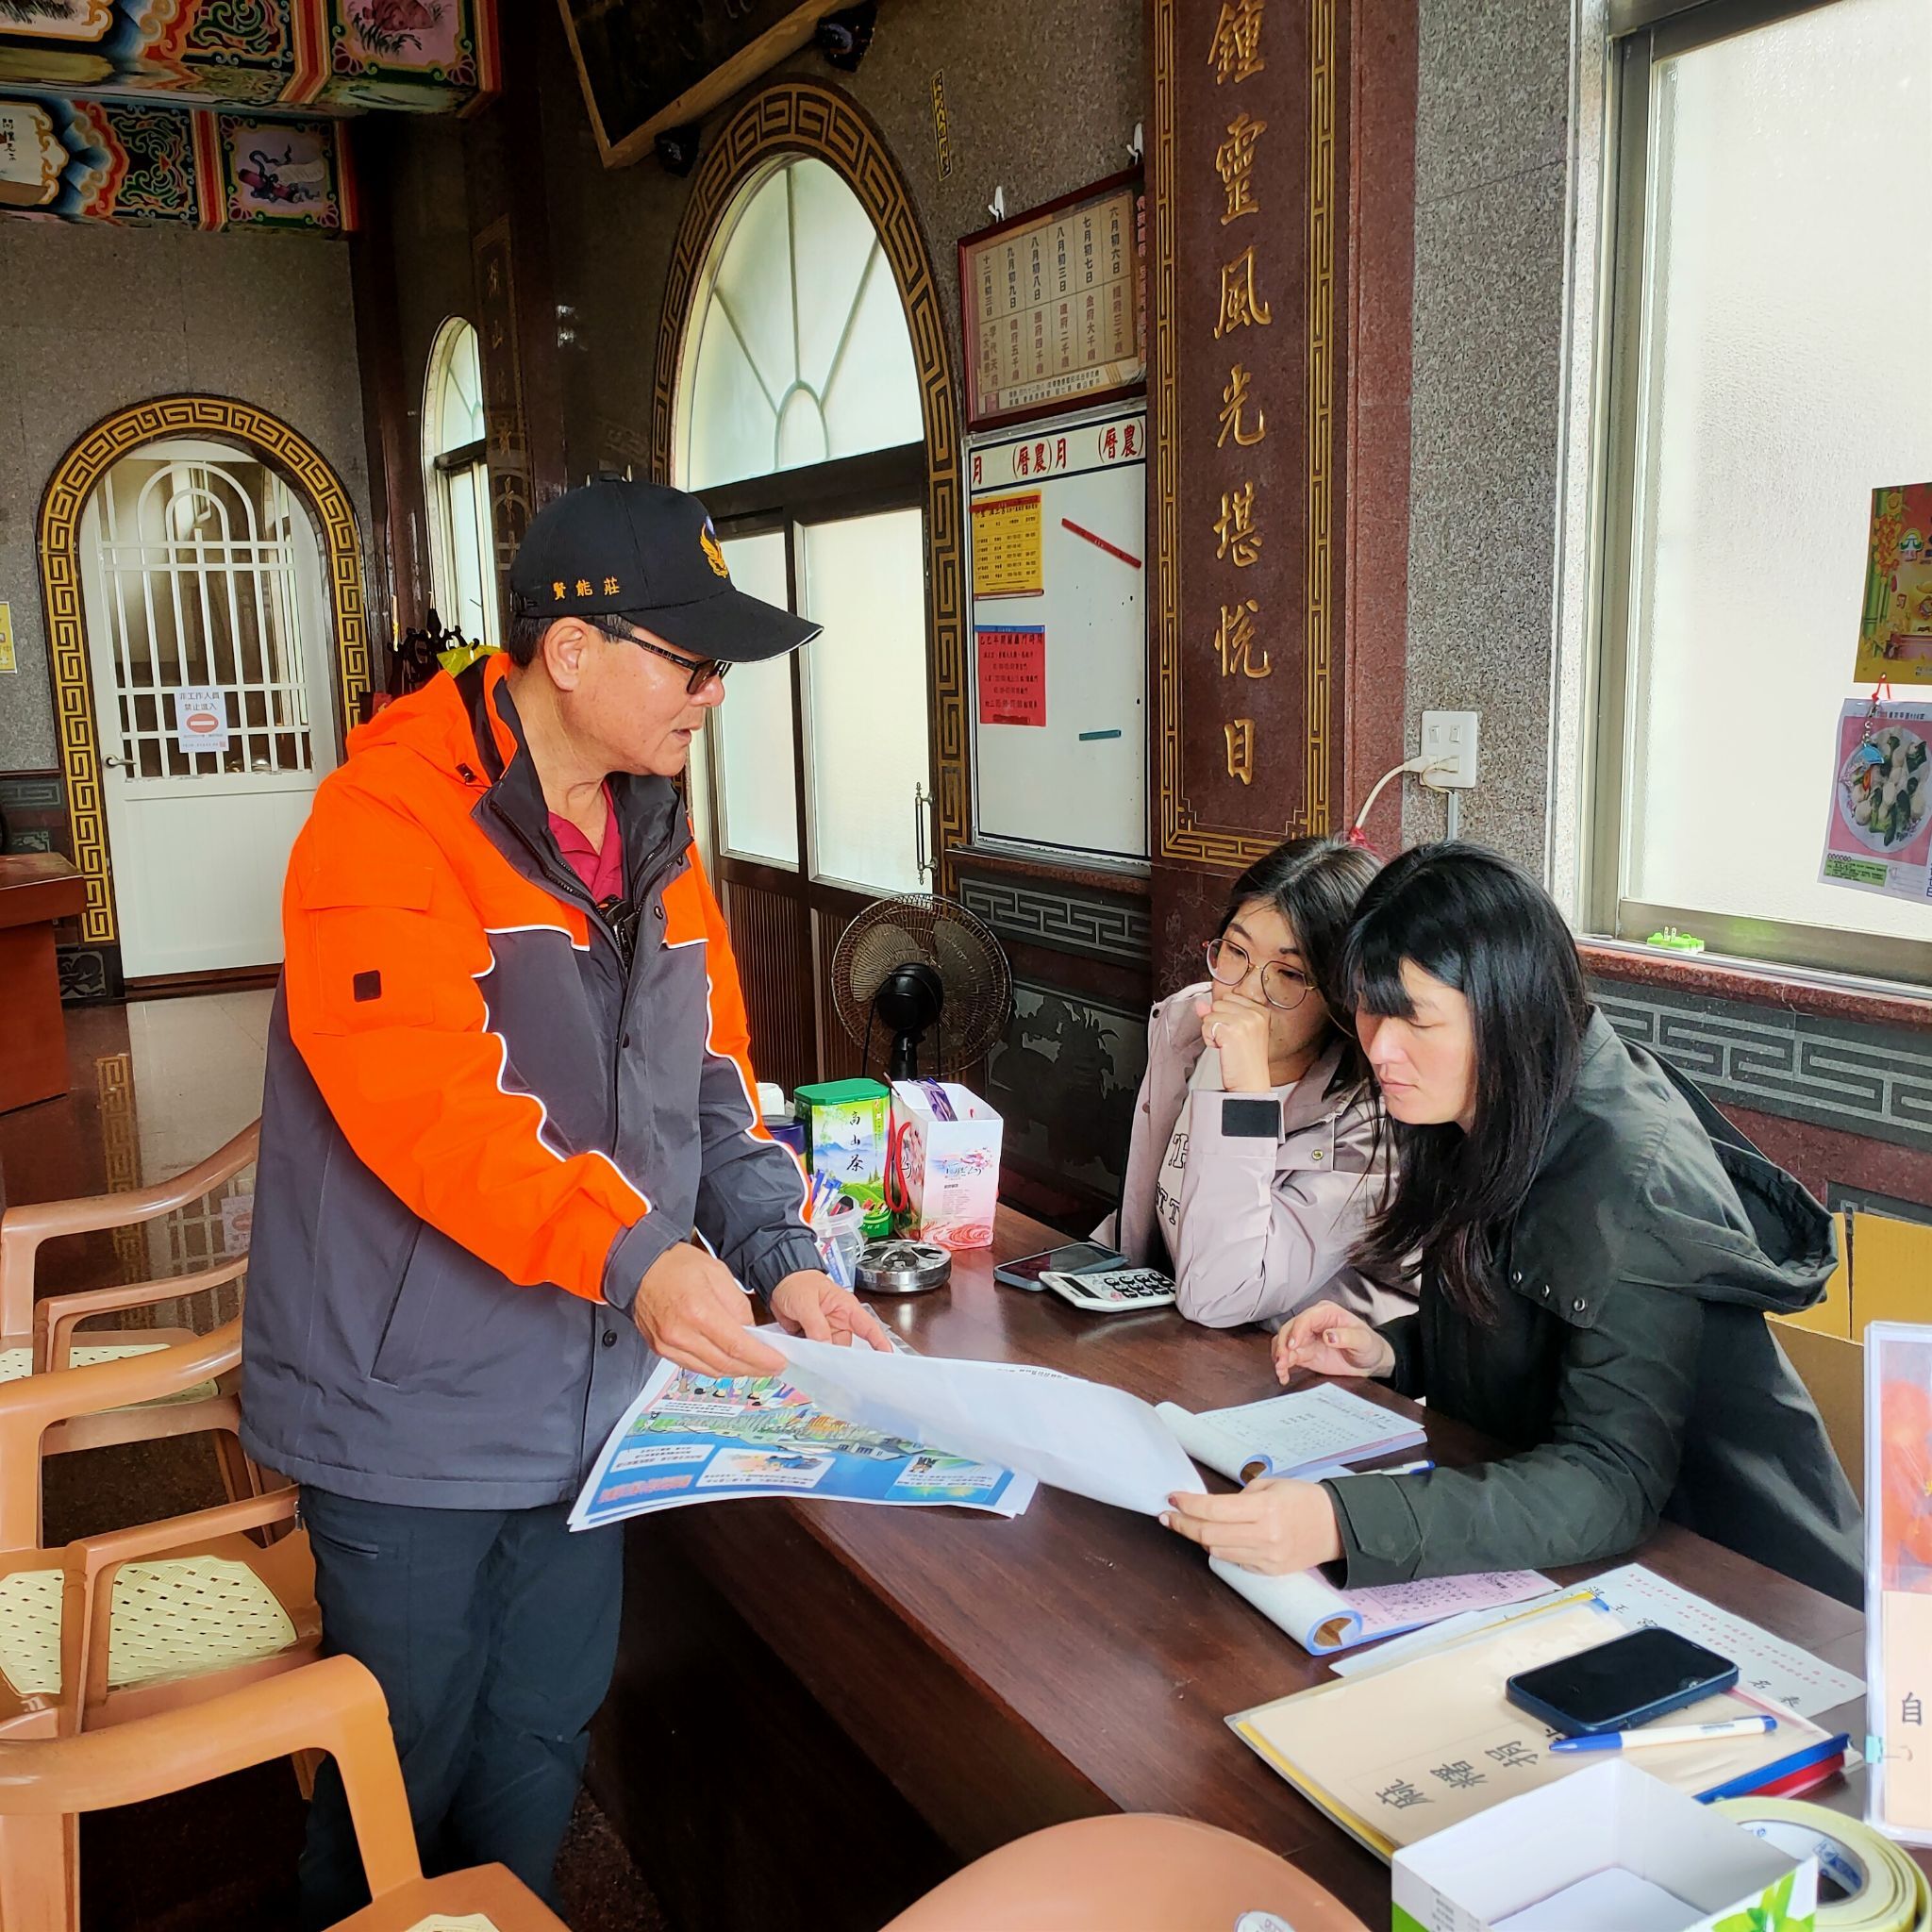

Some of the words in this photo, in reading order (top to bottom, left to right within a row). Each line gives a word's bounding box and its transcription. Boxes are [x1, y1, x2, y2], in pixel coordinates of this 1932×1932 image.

[1082, 216, 1093, 284] 七月初七日
[846, 1110, 864, 1172] 高山茶
